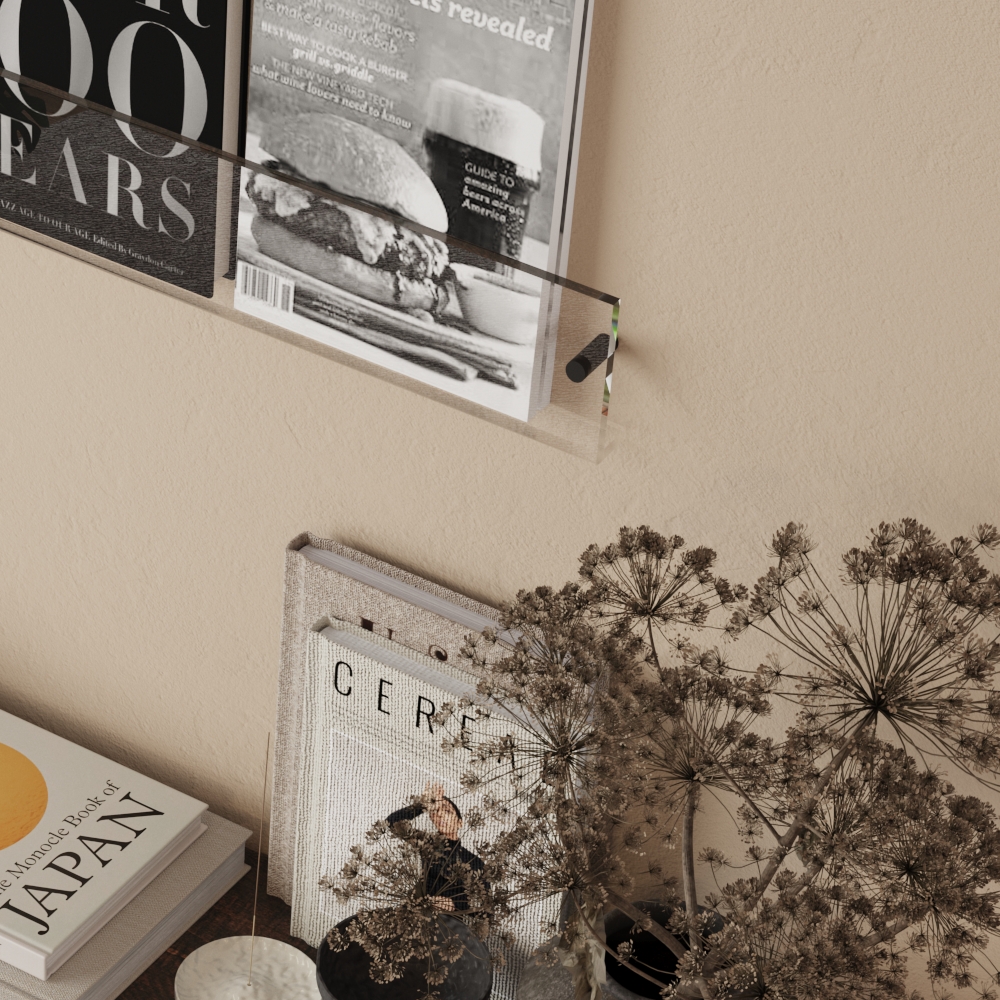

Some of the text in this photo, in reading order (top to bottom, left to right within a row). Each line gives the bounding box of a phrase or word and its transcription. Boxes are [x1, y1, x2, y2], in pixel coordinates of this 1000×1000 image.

[261, 21, 284, 38] BEST
[286, 29, 309, 46] WAY
[310, 39, 326, 53] TO
[326, 45, 358, 64] COOK
[367, 59, 408, 82] BURGER
[276, 2, 311, 24] make
[325, 20, 357, 42] tasty
[360, 30, 398, 54] kebab
[448, 1, 555, 52] revealed
[271, 56, 291, 73] THE
[291, 65, 315, 81] NEW
[367, 92, 394, 111] TECH
[292, 48, 317, 62] grill
[333, 63, 374, 84] griddle
[252, 64, 412, 130] what wine lovers need to know
[462, 184, 490, 204] beers
[463, 175, 510, 201] amazing
[464, 161, 515, 188] GUIDE TO
[461, 198, 507, 223] America
[93, 233, 117, 250] Edited
[334, 660, 516, 770] CERE
[6, 827, 70, 880] Monocle
[62, 795, 106, 828] Book
[102, 779, 122, 797] of
